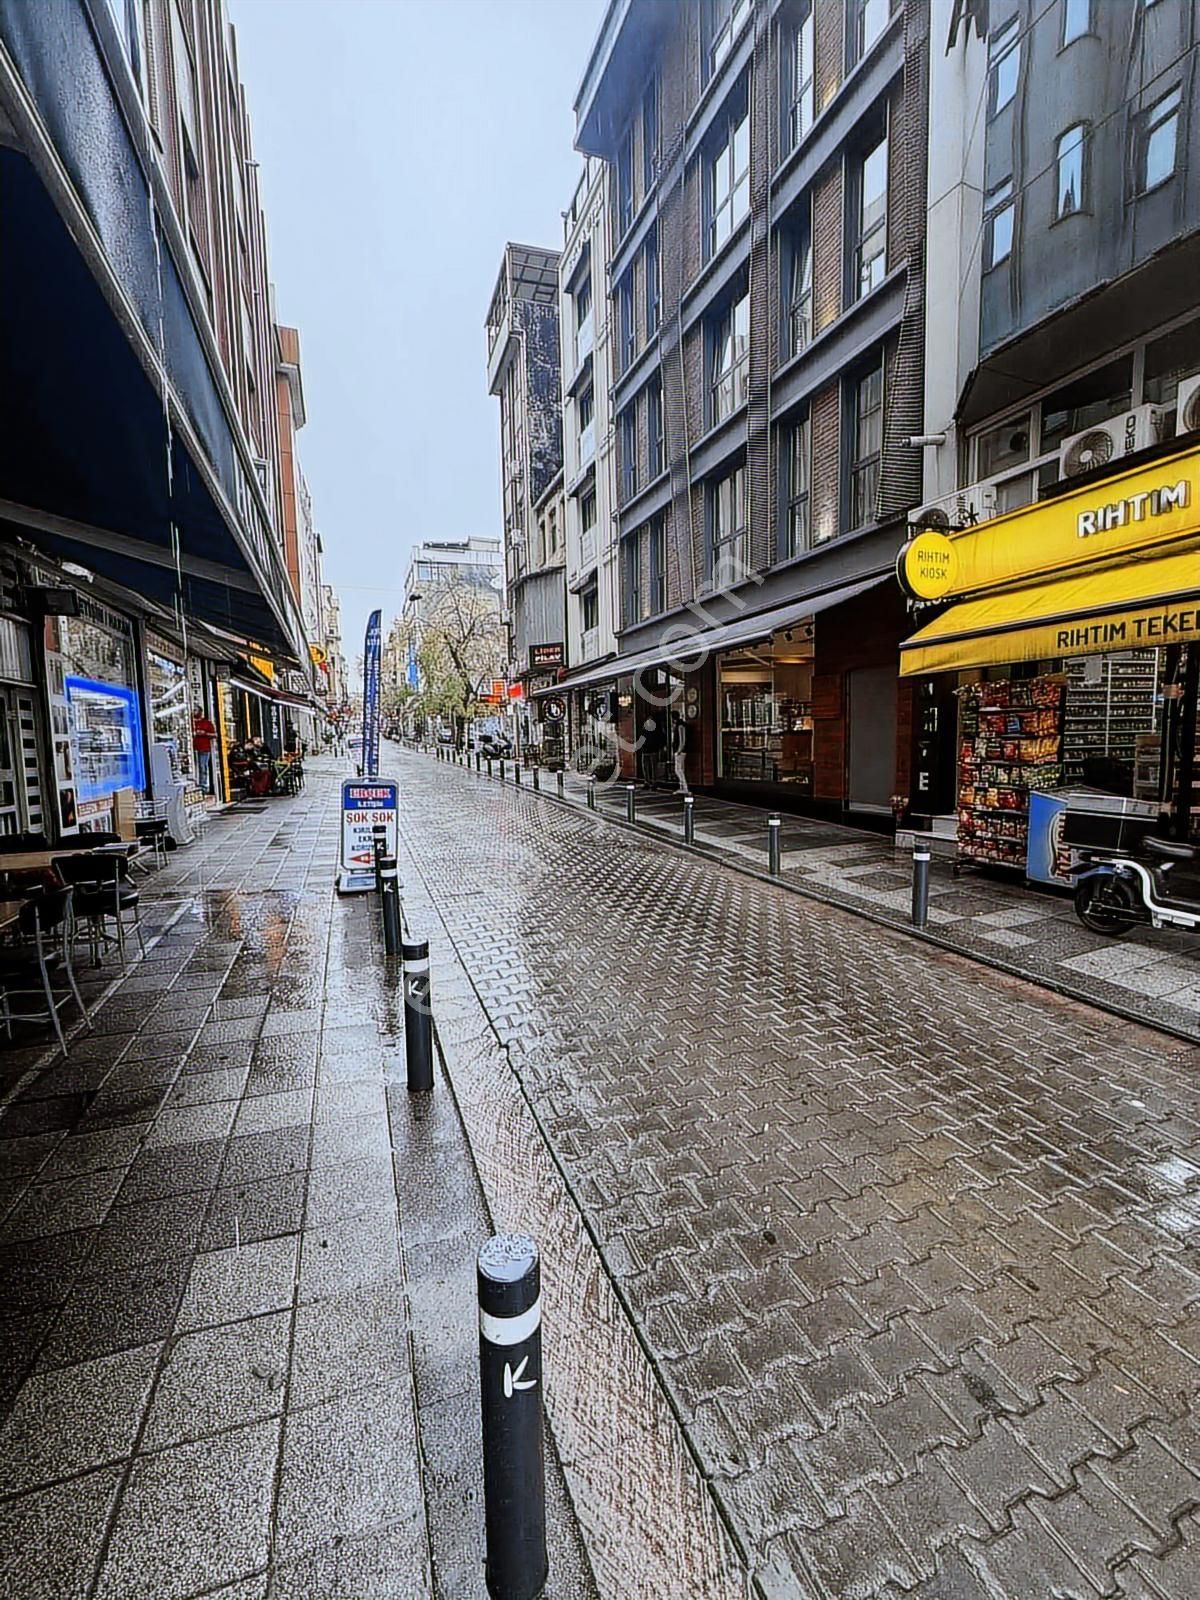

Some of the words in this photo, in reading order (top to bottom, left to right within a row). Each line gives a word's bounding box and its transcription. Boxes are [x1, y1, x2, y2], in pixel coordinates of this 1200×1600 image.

[1077, 480, 1191, 539] RIHTIM
[917, 550, 950, 564] RIHTIM
[920, 567, 948, 580] KIOSK
[1057, 621, 1126, 648] RIHTIM
[503, 1355, 538, 1399] K
